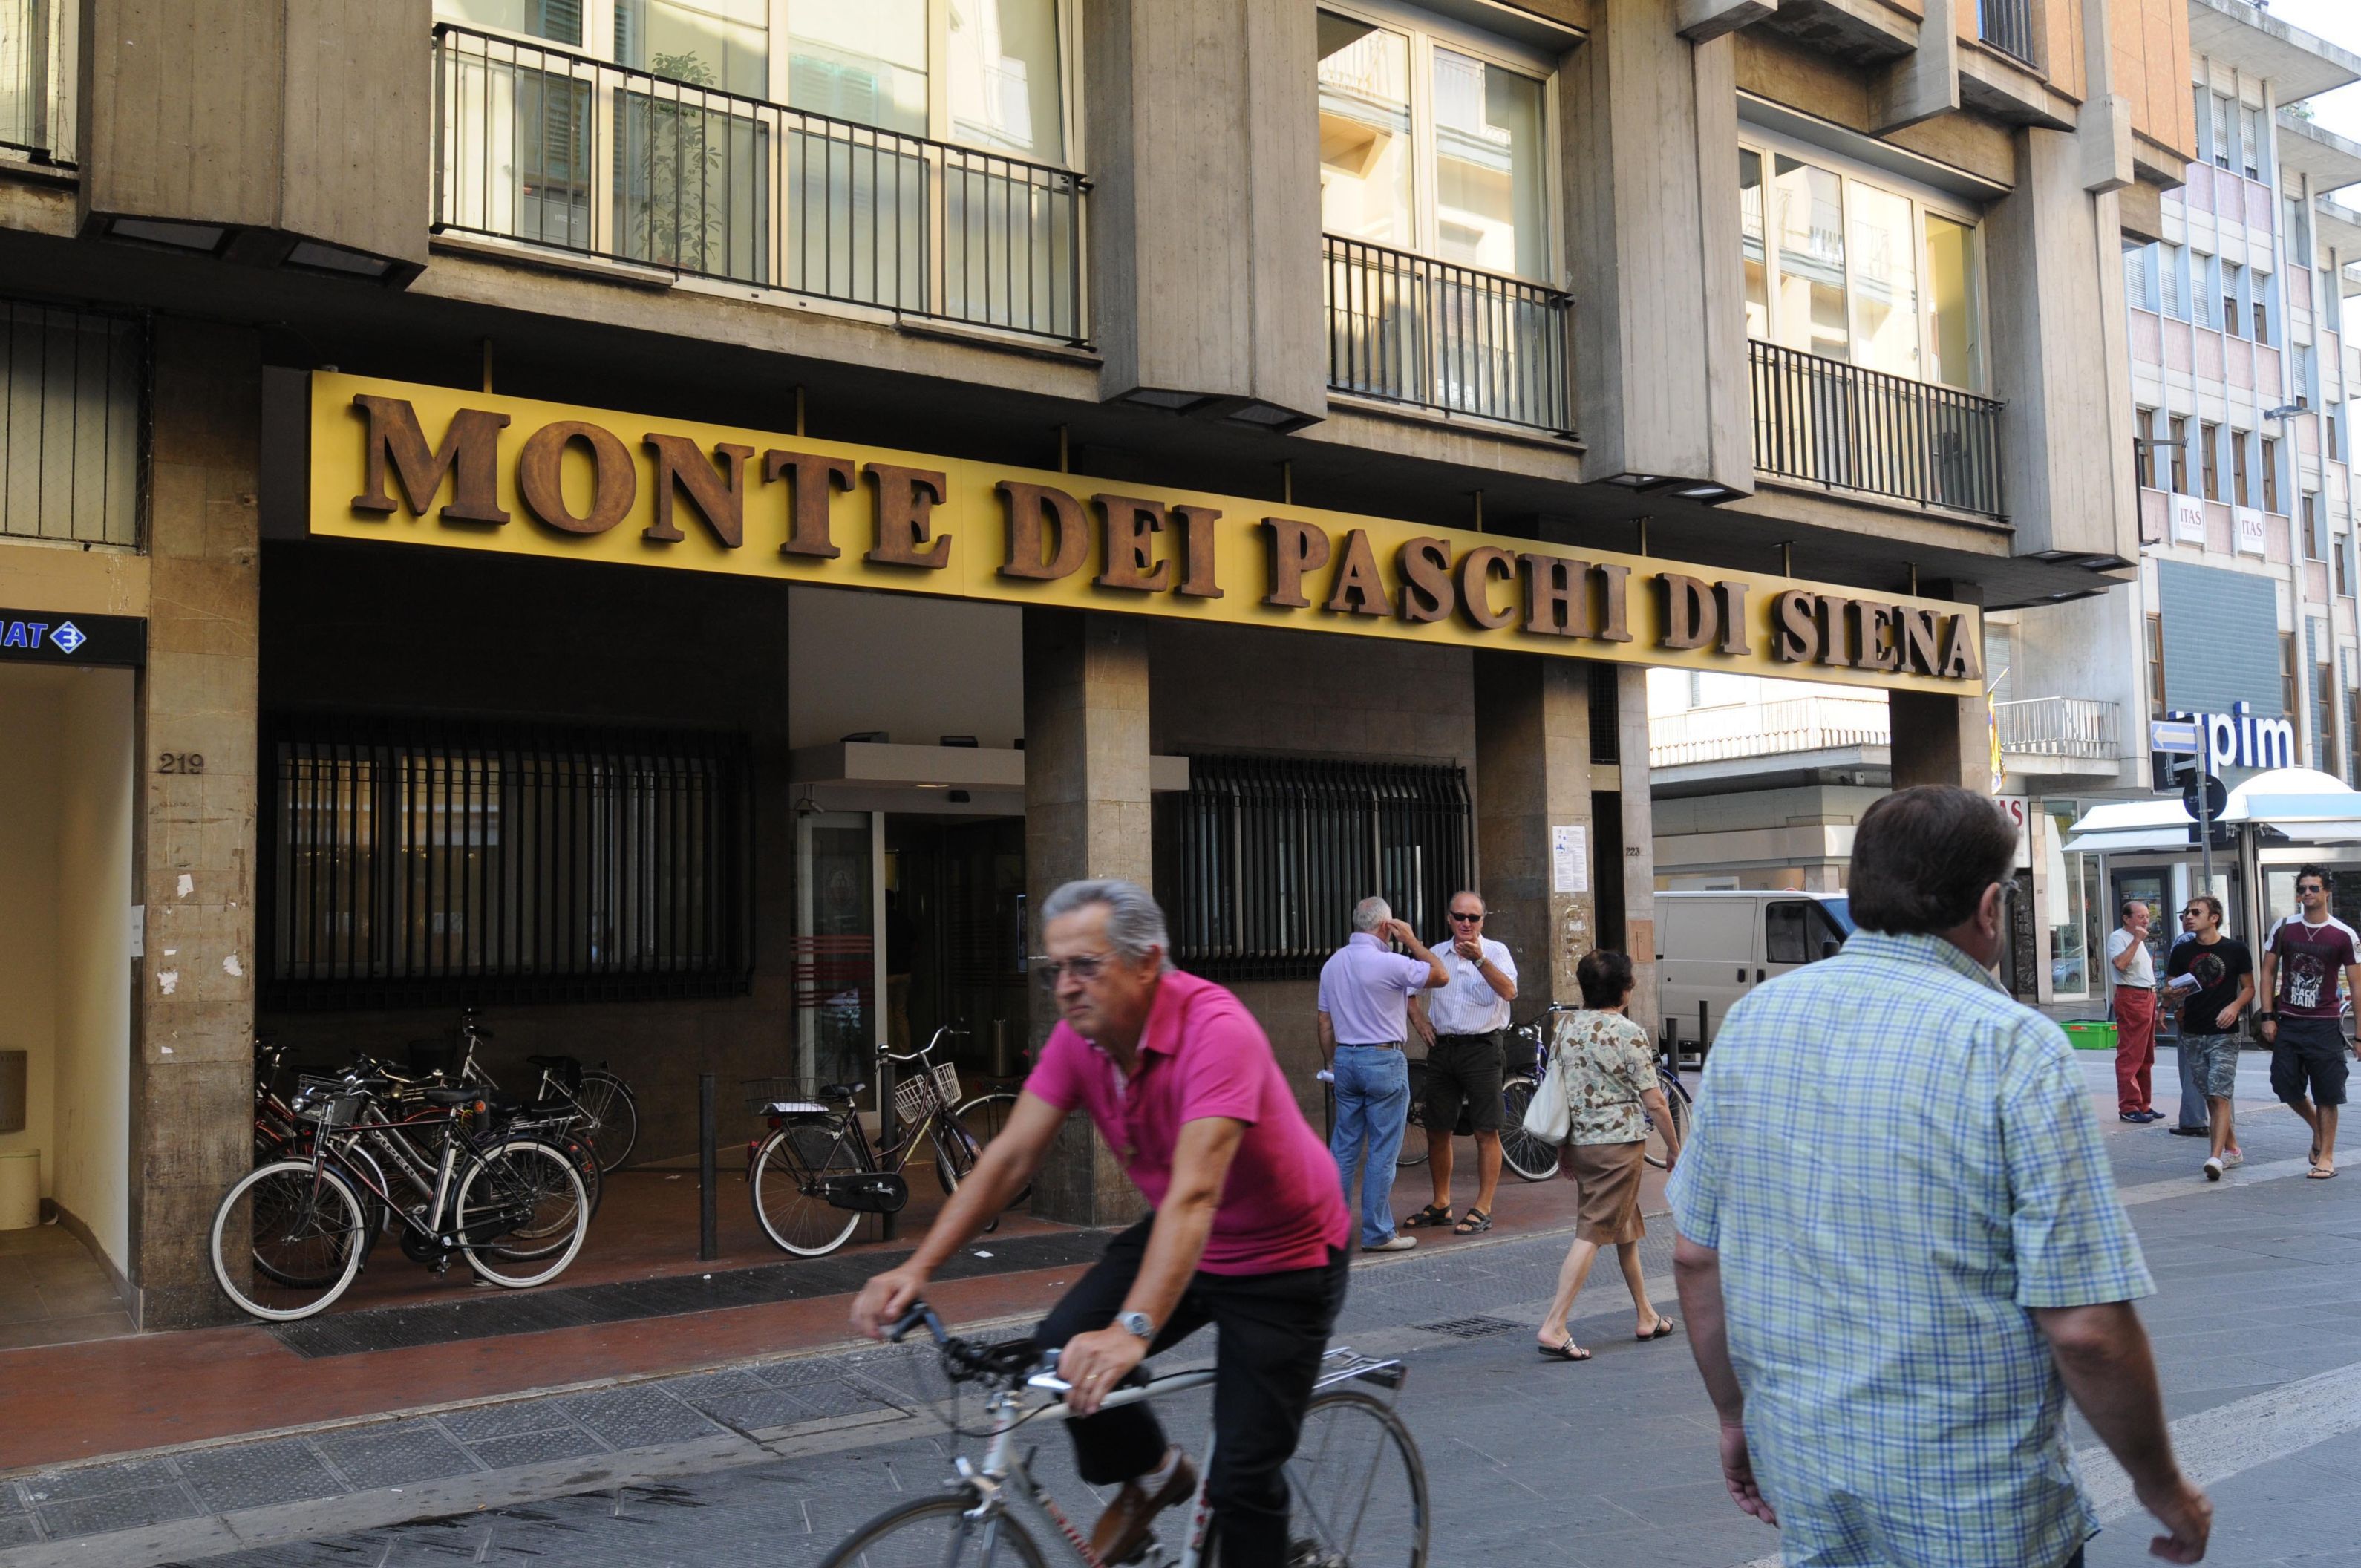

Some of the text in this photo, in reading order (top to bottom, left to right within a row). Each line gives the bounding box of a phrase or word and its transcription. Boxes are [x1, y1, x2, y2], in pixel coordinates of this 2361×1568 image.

[2180, 508, 2201, 525] ITAS
[2241, 520, 2262, 536] ITAS
[351, 393, 1982, 680] MONTE DEI PASCHI DI SIENA
[0, 621, 48, 648] AT
[158, 753, 204, 774] 219
[1626, 847, 1639, 856] 223
[2291, 987, 2316, 997] BLACK
[2290, 996, 2315, 1007] RAIN
